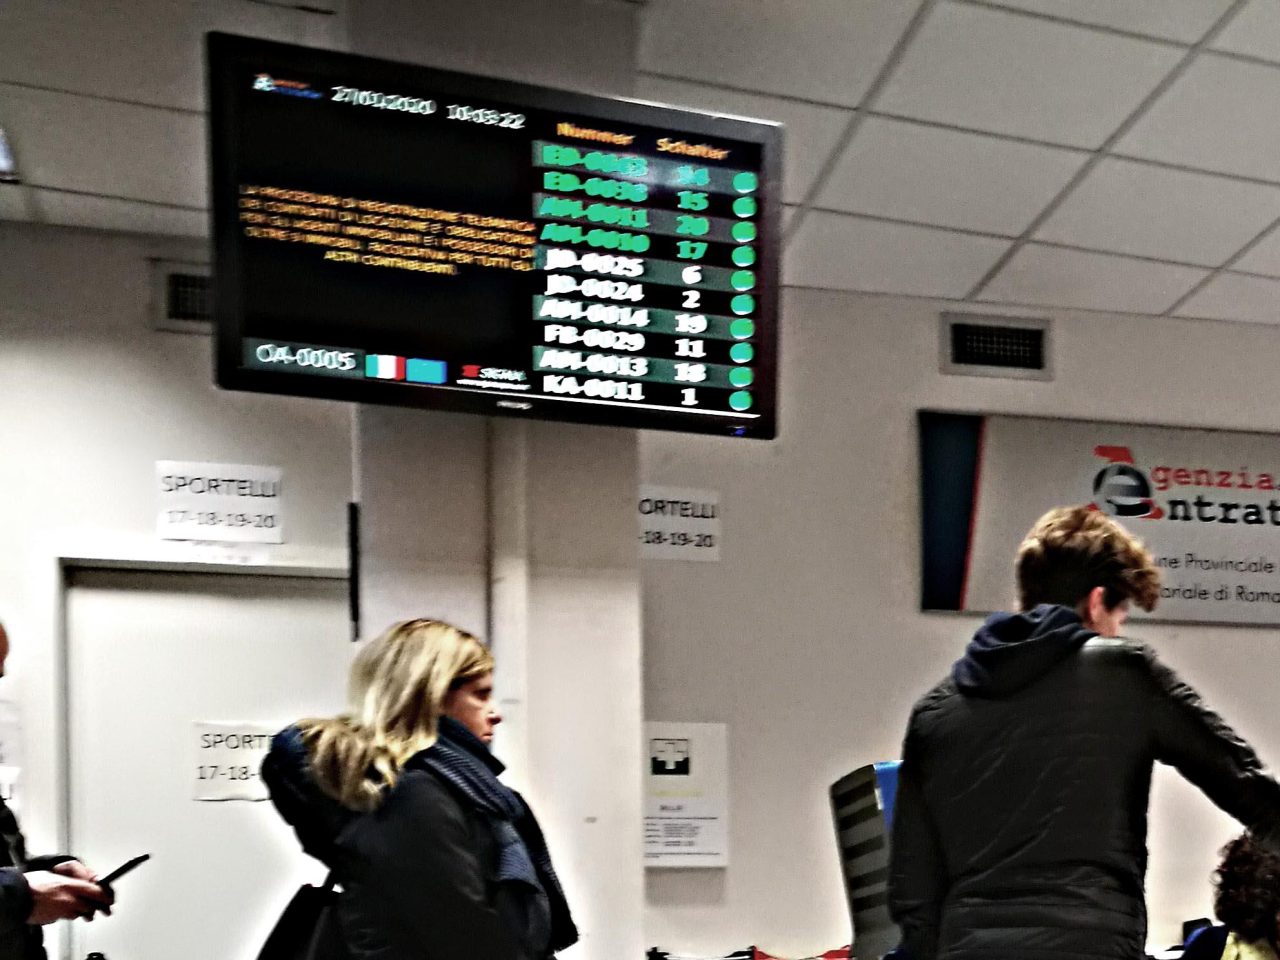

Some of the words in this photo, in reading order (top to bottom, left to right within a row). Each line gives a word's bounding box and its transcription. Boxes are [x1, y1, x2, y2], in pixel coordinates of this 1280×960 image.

[681, 265, 702, 285] 6
[681, 290, 701, 309] 2
[674, 313, 708, 334] 19
[674, 338, 707, 358] 11
[674, 362, 707, 383] 18
[681, 387, 699, 406] 1
[161, 474, 277, 499] SPORTELLI
[166, 509, 276, 529] 17-18-19-20
[1184, 552, 1274, 575] Provinciale
[1213, 584, 1229, 603] di
